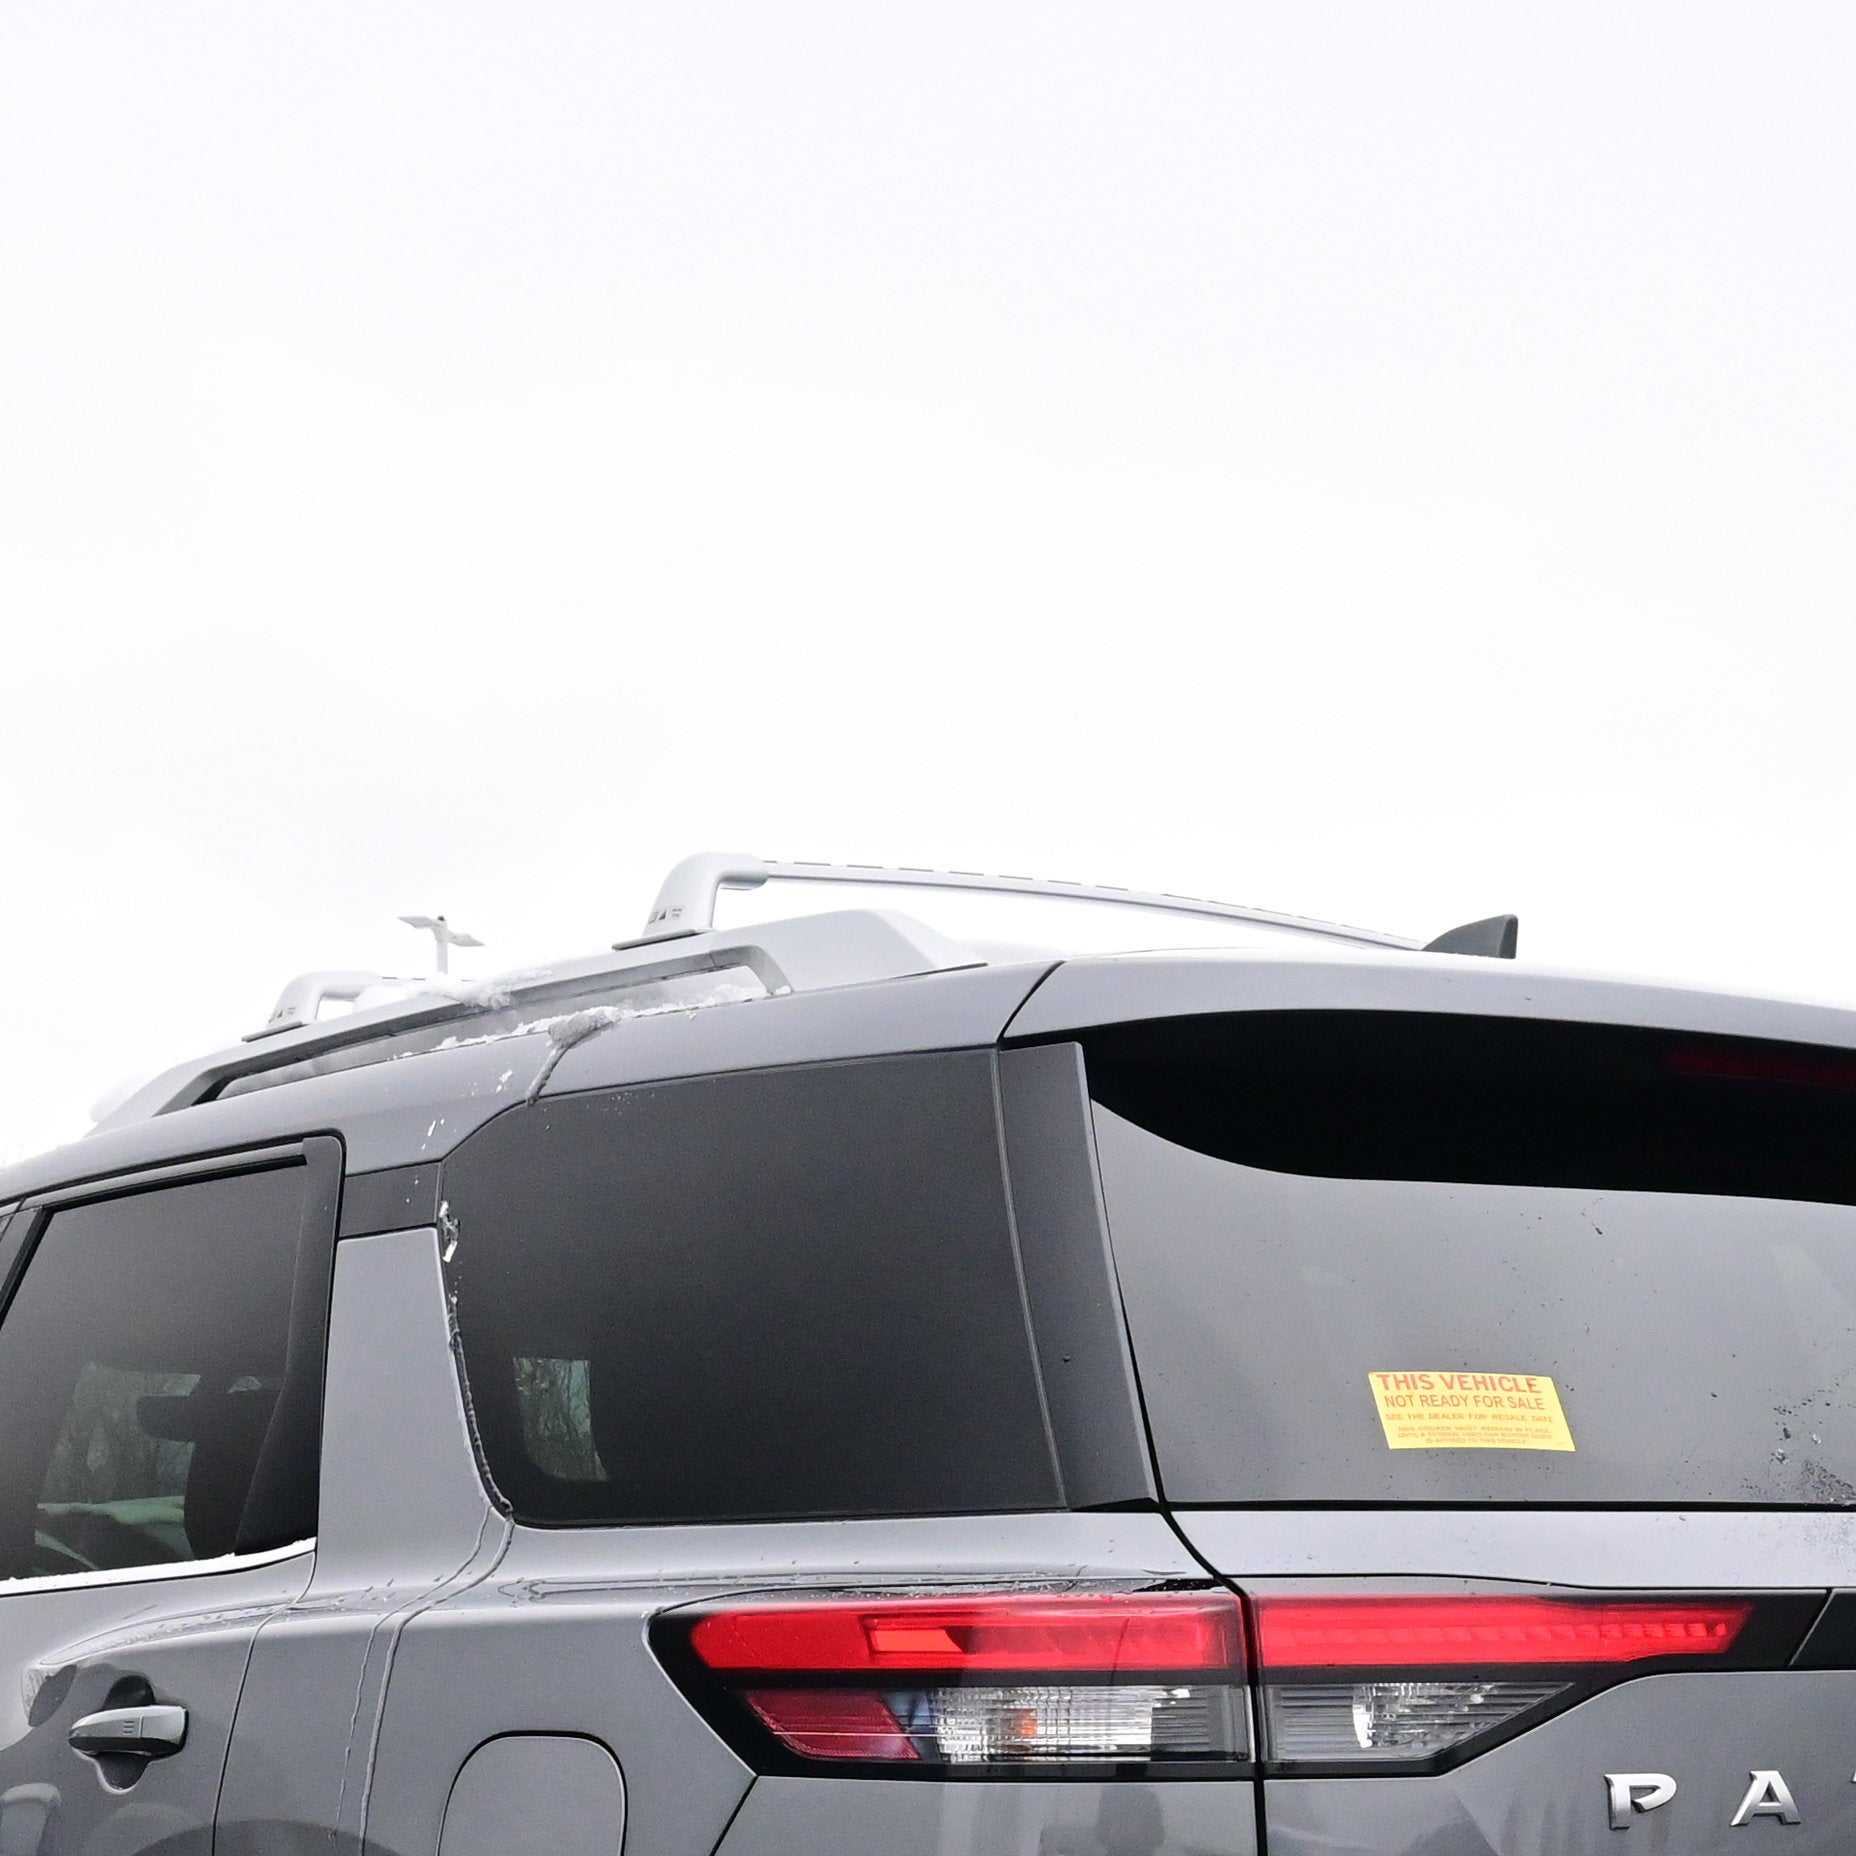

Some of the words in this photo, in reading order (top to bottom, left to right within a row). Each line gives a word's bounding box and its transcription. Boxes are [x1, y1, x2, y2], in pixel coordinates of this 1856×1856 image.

[1376, 1374, 1434, 1390] THIS
[1439, 1374, 1542, 1394] VEHICLE
[1384, 1395, 1415, 1408] NOT
[1419, 1394, 1468, 1408] READY
[1473, 1395, 1504, 1408] FOR
[1507, 1396, 1546, 1410] SALE
